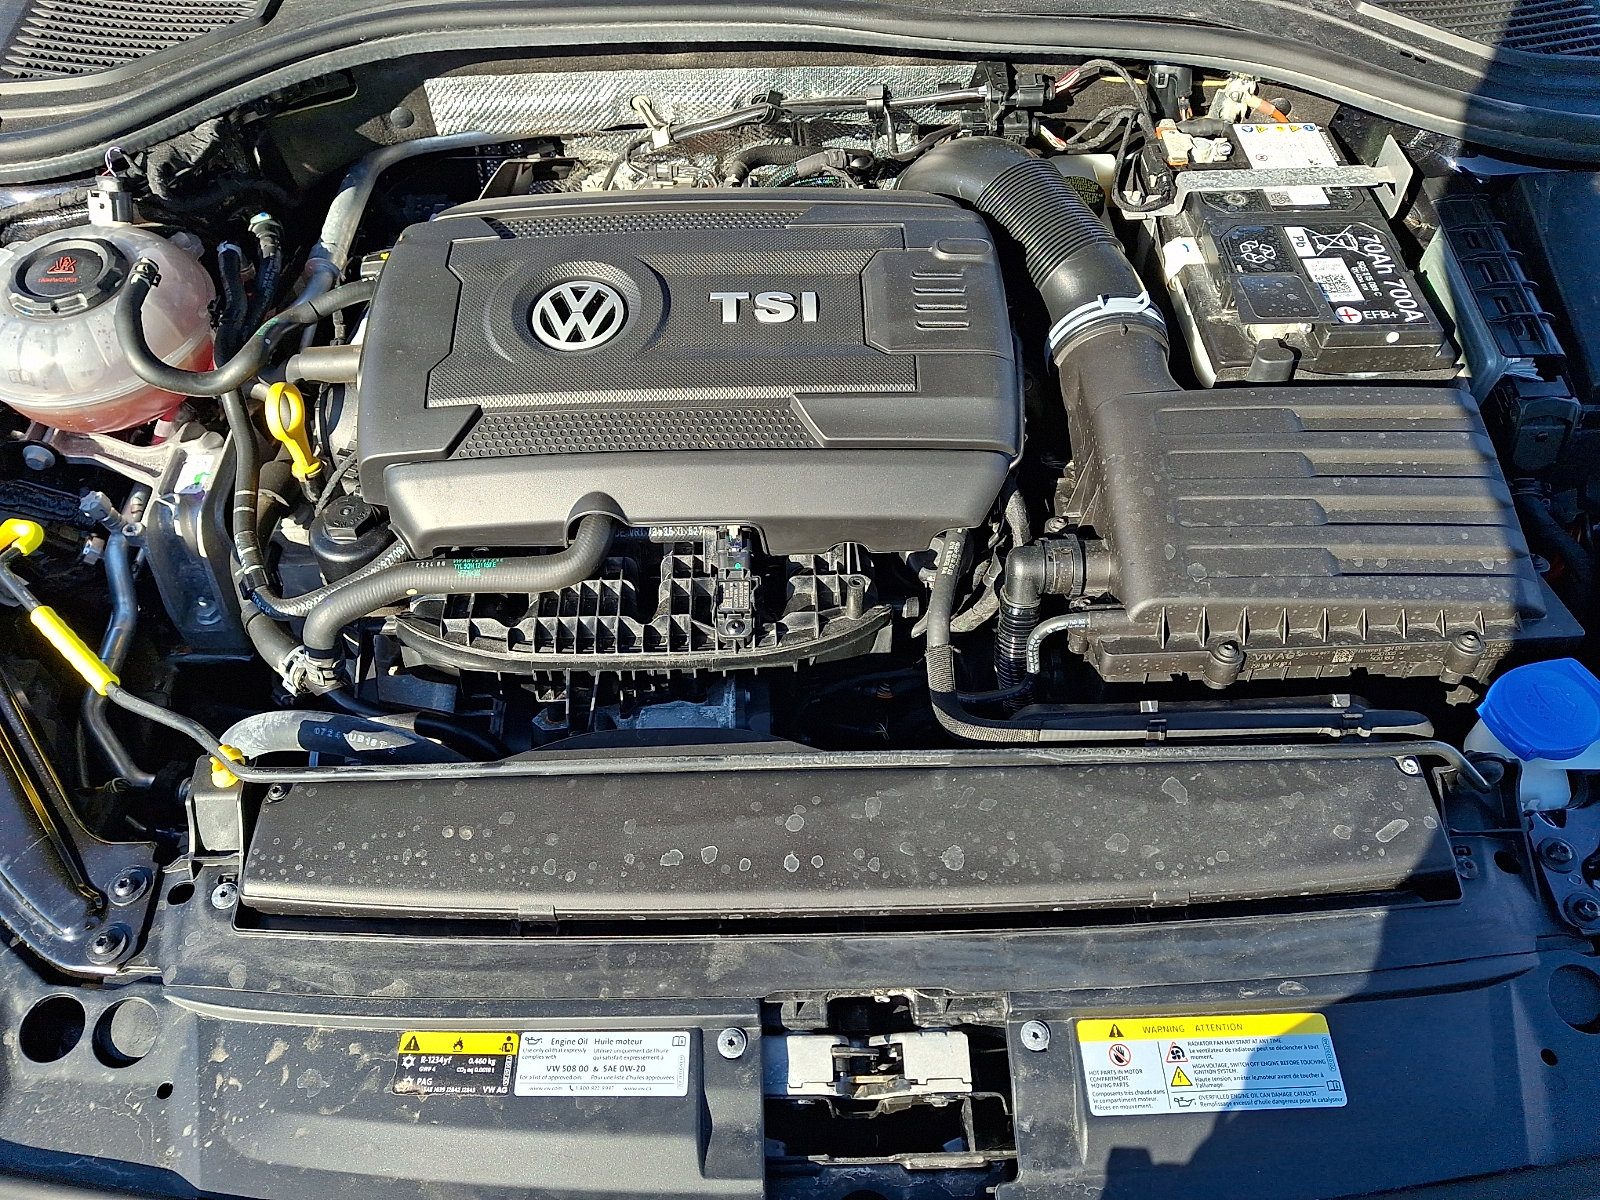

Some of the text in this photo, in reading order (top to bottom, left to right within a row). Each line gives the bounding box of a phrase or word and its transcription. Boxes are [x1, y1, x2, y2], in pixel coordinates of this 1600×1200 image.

[1292, 235, 1307, 248] Pb
[1357, 233, 1425, 323] 70Ah 700A
[709, 291, 819, 324] TSI
[532, 280, 625, 351] VW
[1362, 309, 1399, 320] EFB+
[1252, 653, 1276, 661] VW
[1142, 1023, 1243, 1034] WARNING ATTENTION
[551, 1037, 588, 1047] Engine Oil
[420, 1056, 452, 1066] R-1234yf
[487, 1058, 496, 1067] kg
[546, 1064, 561, 1072] VW
[562, 1064, 577, 1072] 508
[578, 1064, 589, 1072] 00
[603, 1064, 618, 1073] SAE
[619, 1064, 646, 1073] 0W-20
[417, 1078, 433, 1086] PAG
[483, 1085, 496, 1094] VW
[496, 1085, 508, 1094] AG
[1230, 1092, 1251, 1100] ENGINE
[1271, 1090, 1293, 1098] DAMAGE
[1200, 1100, 1232, 1108] Remplissage
[1271, 1098, 1300, 1106] dangereux
